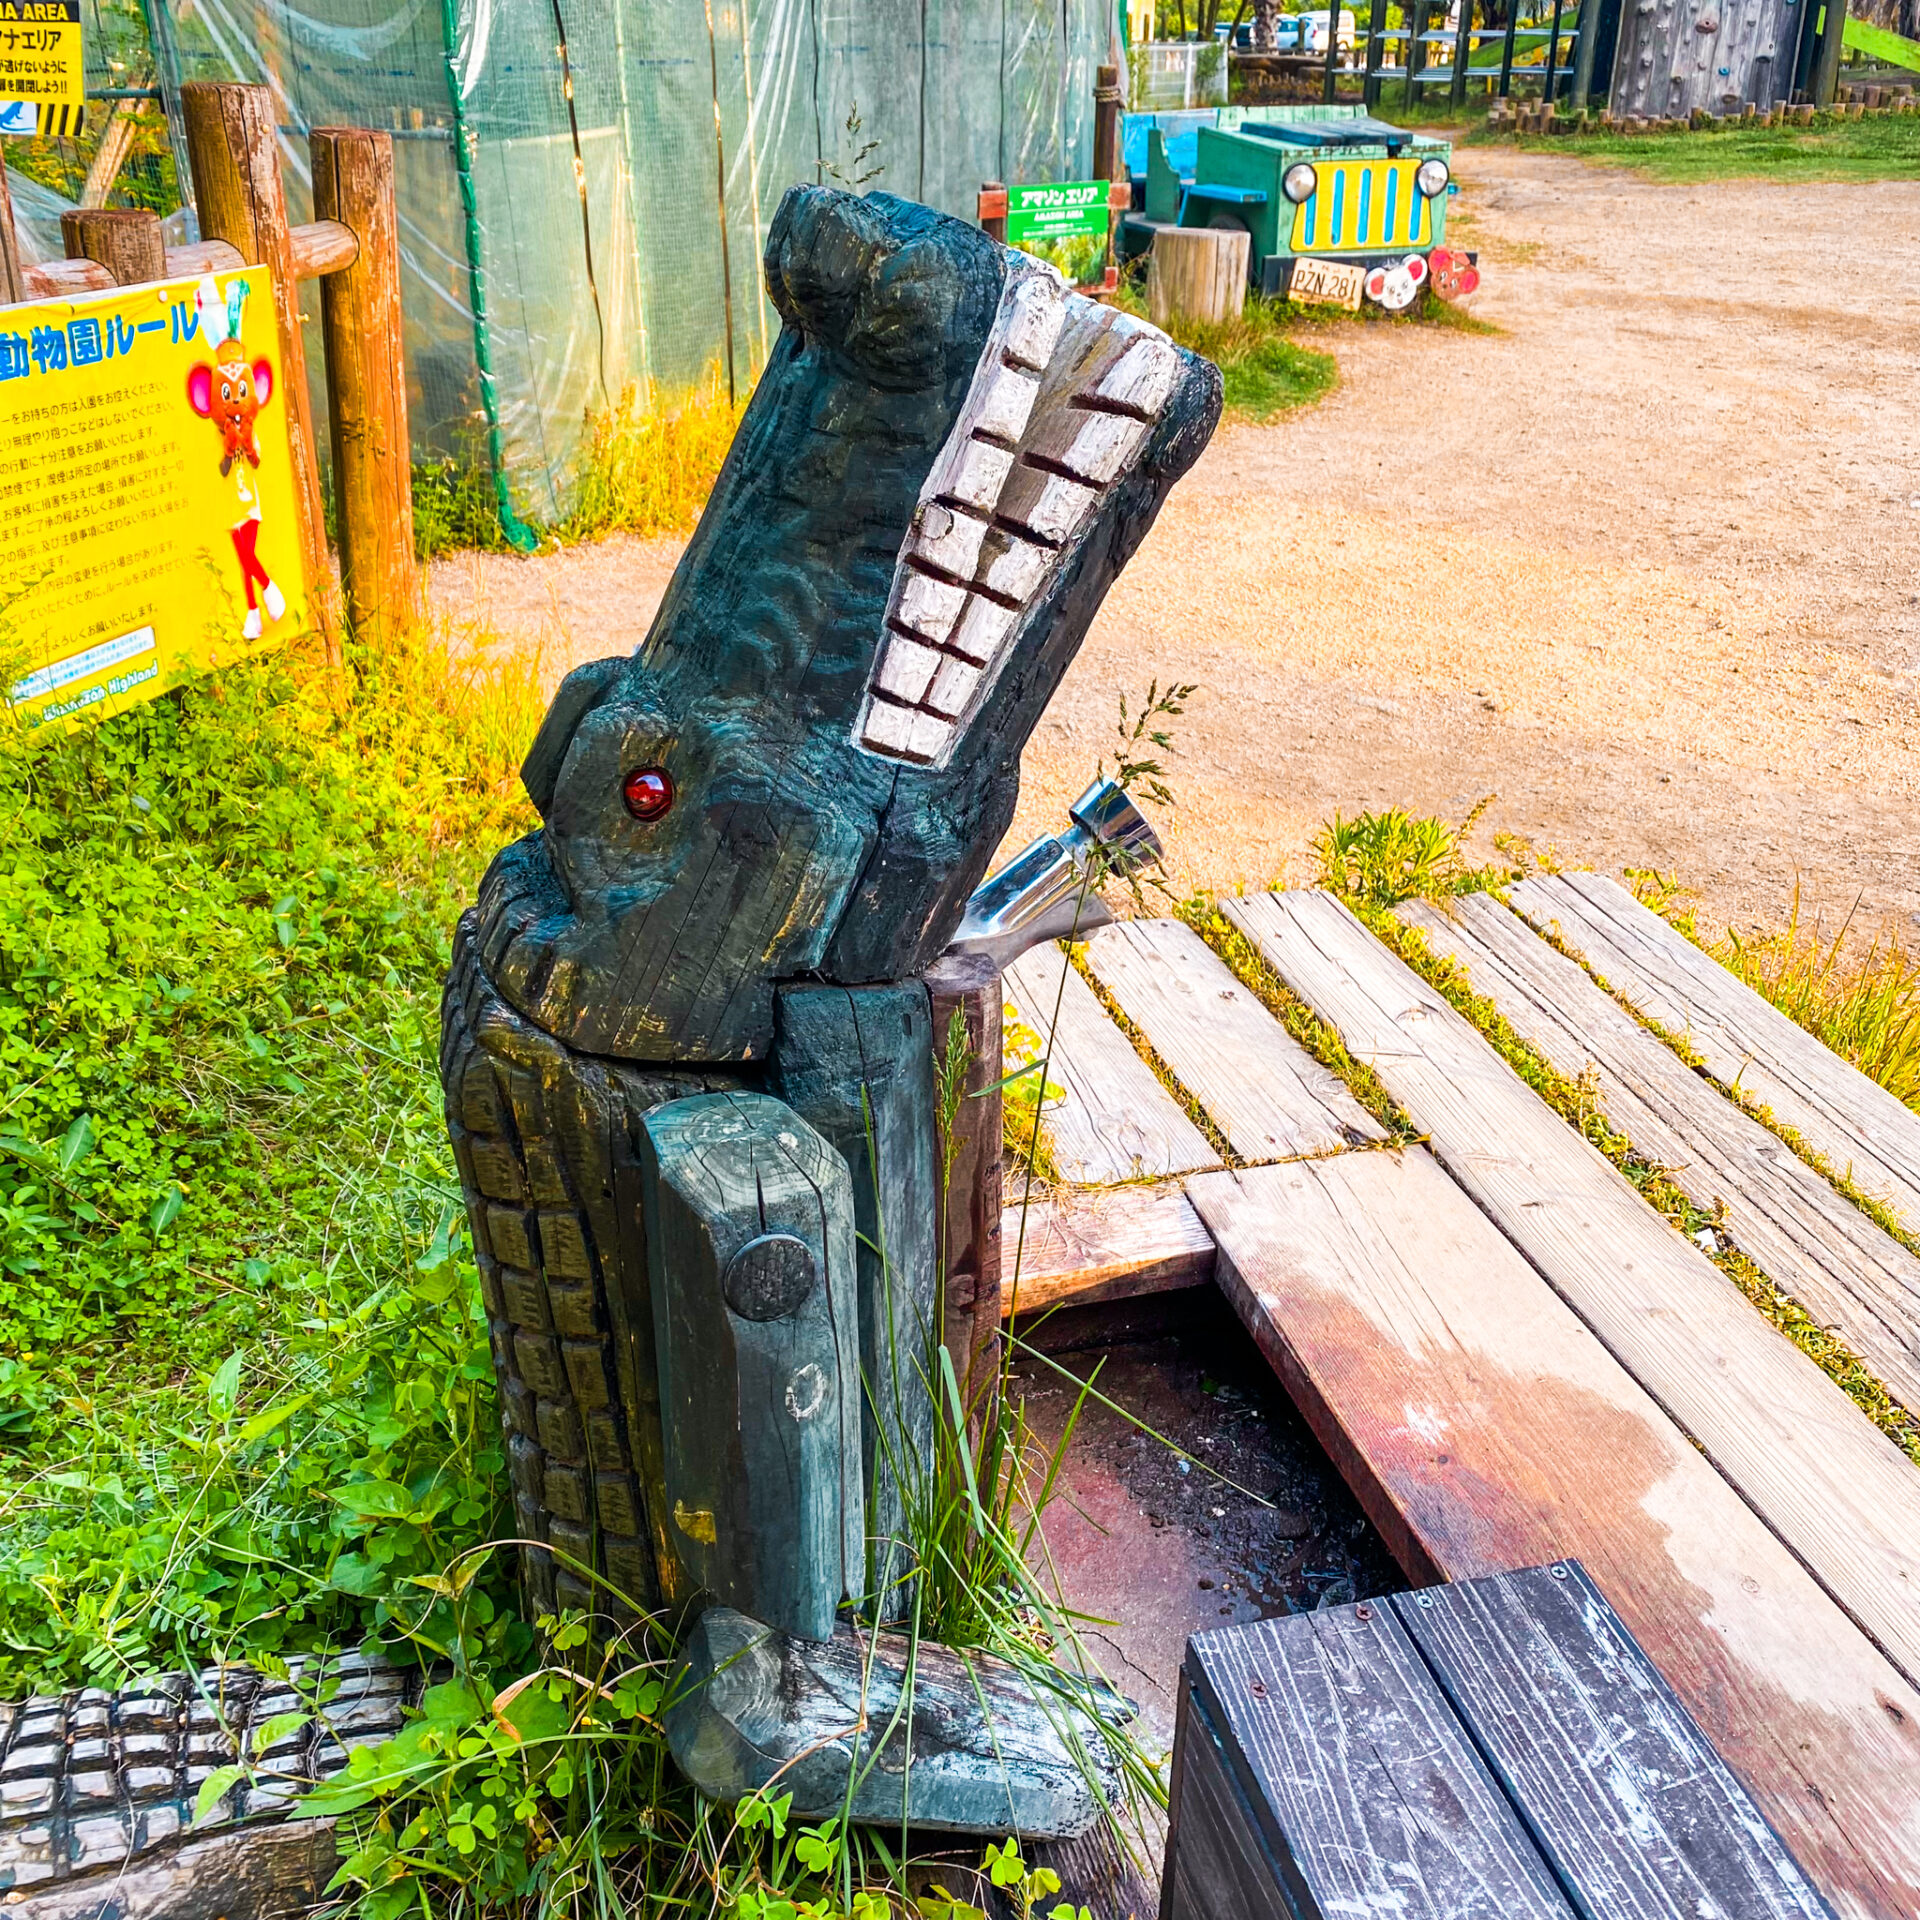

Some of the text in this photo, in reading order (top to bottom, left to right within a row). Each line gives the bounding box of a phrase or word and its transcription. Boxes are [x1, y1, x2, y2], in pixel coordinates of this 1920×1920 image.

[22, 3, 70, 21] AREA
[0, 28, 61, 51] ナエリア
[1021, 187, 1098, 208] アマゾン エリア
[1294, 270, 1326, 295] PZN
[1327, 275, 1357, 299] 281
[0, 301, 199, 381] 動物園ルール
[0, 401, 175, 452] り無理やり抱っこなどはしないでください。
[107, 657, 158, 695] Highland
